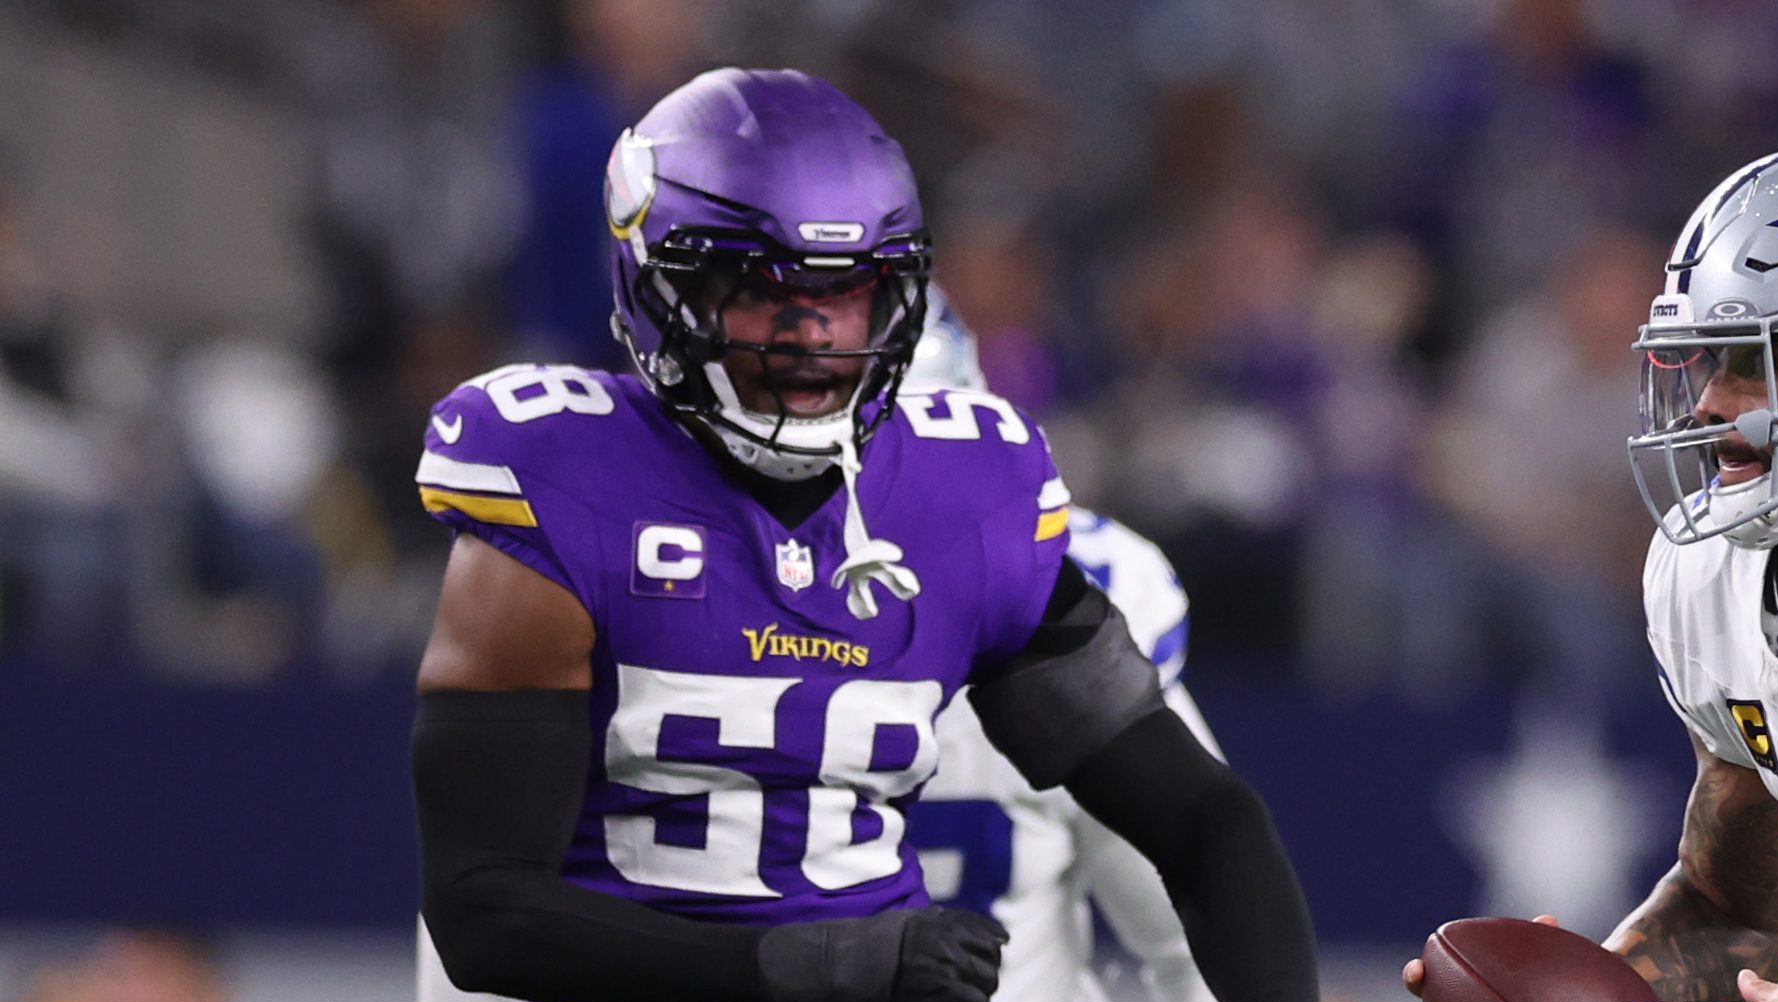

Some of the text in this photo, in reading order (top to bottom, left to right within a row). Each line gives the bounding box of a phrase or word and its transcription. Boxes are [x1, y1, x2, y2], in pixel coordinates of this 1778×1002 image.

[457, 363, 615, 424] 8
[637, 525, 703, 580] C
[1732, 705, 1769, 754] C
[604, 664, 943, 898] 58
